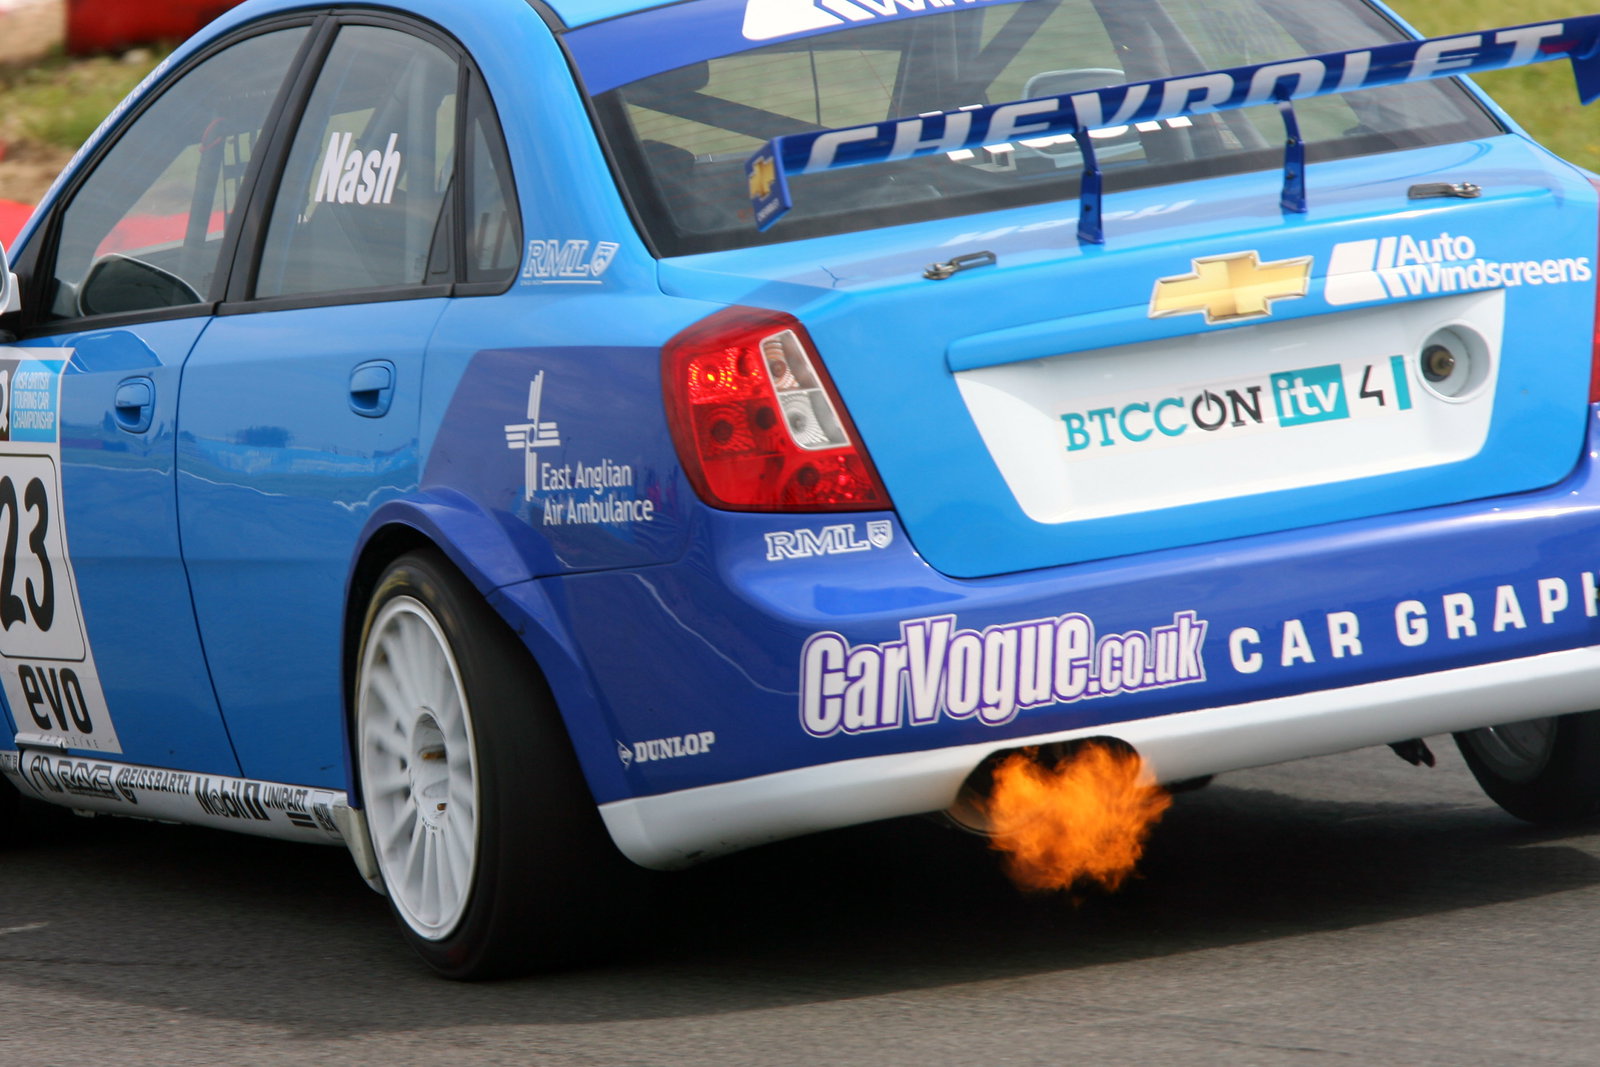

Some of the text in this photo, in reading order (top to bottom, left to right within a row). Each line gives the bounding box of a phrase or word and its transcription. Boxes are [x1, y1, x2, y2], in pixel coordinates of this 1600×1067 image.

[314, 131, 401, 205] Nash
[522, 239, 590, 278] RML
[1397, 232, 1476, 266] Auto
[1399, 256, 1592, 296] Windscreens
[38, 391, 50, 410] CAR
[1276, 377, 1339, 418] itv
[13, 410, 55, 430] CHAMPIONSHIP
[541, 458, 632, 495] East Anglian
[543, 493, 654, 526] Air Ambulance
[0, 475, 55, 632] 23
[764, 523, 872, 561] RML
[1229, 611, 1363, 674] CAR
[18, 664, 93, 734] evo
[633, 731, 715, 763] DUNLOP
[122, 767, 191, 796] BEISSBARTH
[195, 776, 250, 819] Mobil
[263, 785, 308, 812] UNIPART
